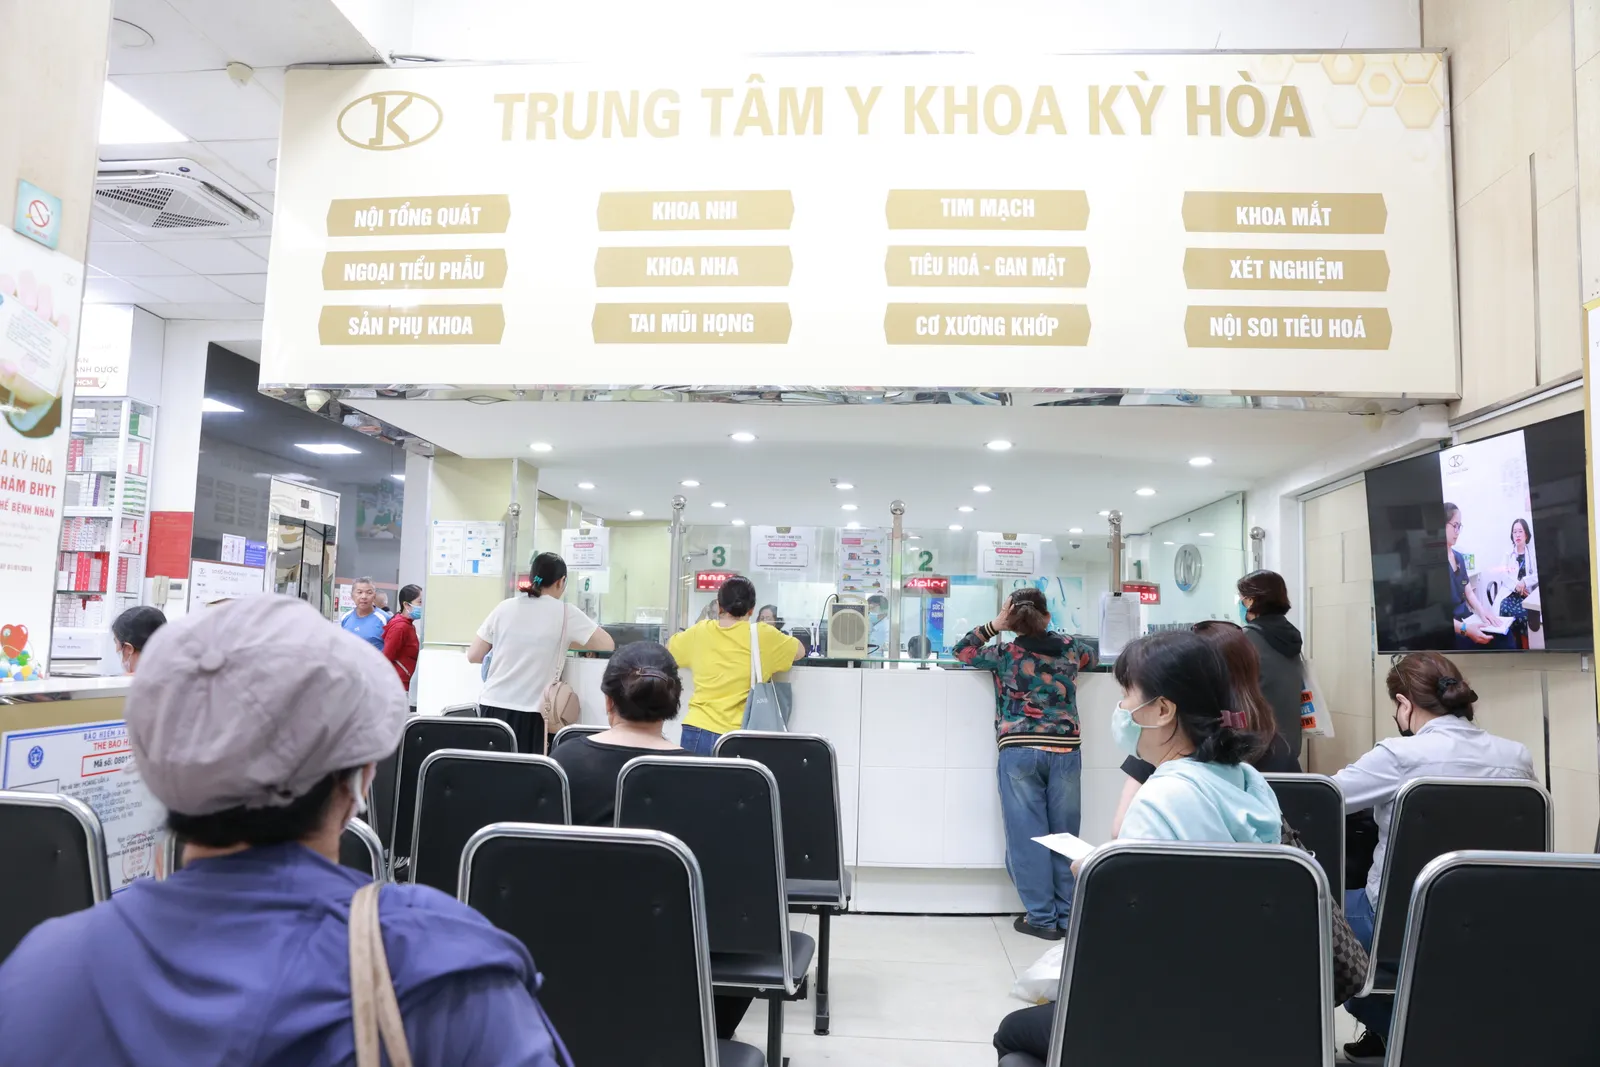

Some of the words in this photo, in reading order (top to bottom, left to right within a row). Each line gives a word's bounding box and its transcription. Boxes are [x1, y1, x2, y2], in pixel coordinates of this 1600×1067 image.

[494, 88, 680, 140] TRUNG
[702, 74, 824, 136] TÂM
[846, 86, 882, 135] Y
[904, 86, 1067, 136] KHOA
[1088, 71, 1165, 136] KỲ
[1186, 71, 1312, 138] HÒA
[354, 206, 384, 231] NỘI
[389, 201, 433, 227] TỔNG
[437, 203, 482, 228] QUÁT
[652, 201, 701, 220] KHOA
[706, 201, 739, 220] NHI
[941, 198, 975, 218] TIM
[980, 199, 1036, 222] MẠCH
[1236, 207, 1287, 227] KHOA
[1292, 200, 1334, 228] MẮT
[344, 263, 395, 285] NGOẠI
[399, 255, 436, 281] TIỂU
[440, 254, 485, 281] PHẪU
[646, 256, 696, 276] KHOA
[700, 256, 740, 276] NHA
[909, 252, 944, 276] TIÊU
[948, 253, 981, 276] HOÁ
[995, 257, 1029, 277] GAN
[1032, 253, 1067, 281] MẬT
[1230, 256, 1265, 281] XÉT
[1270, 257, 1345, 285] NGHIỆM
[348, 311, 384, 336] SẢN
[388, 316, 424, 339] PHỤ
[428, 315, 474, 335] KHOA
[629, 313, 657, 333] TAI
[661, 309, 699, 333] MŨI
[703, 313, 756, 337] HỌNG
[916, 314, 941, 336] CƠ
[945, 314, 1007, 336] XƯƠNG
[1011, 313, 1061, 337] KHỚP
[1209, 313, 1244, 341] NỘI
[1248, 318, 1279, 339] SOI
[1284, 314, 1324, 339] TIÊU
[1328, 315, 1367, 340] HOÁ
[711, 546, 726, 567] 3
[918, 550, 933, 572] 2
[1133, 559, 1142, 580] 1
[583, 576, 591, 592] 6
